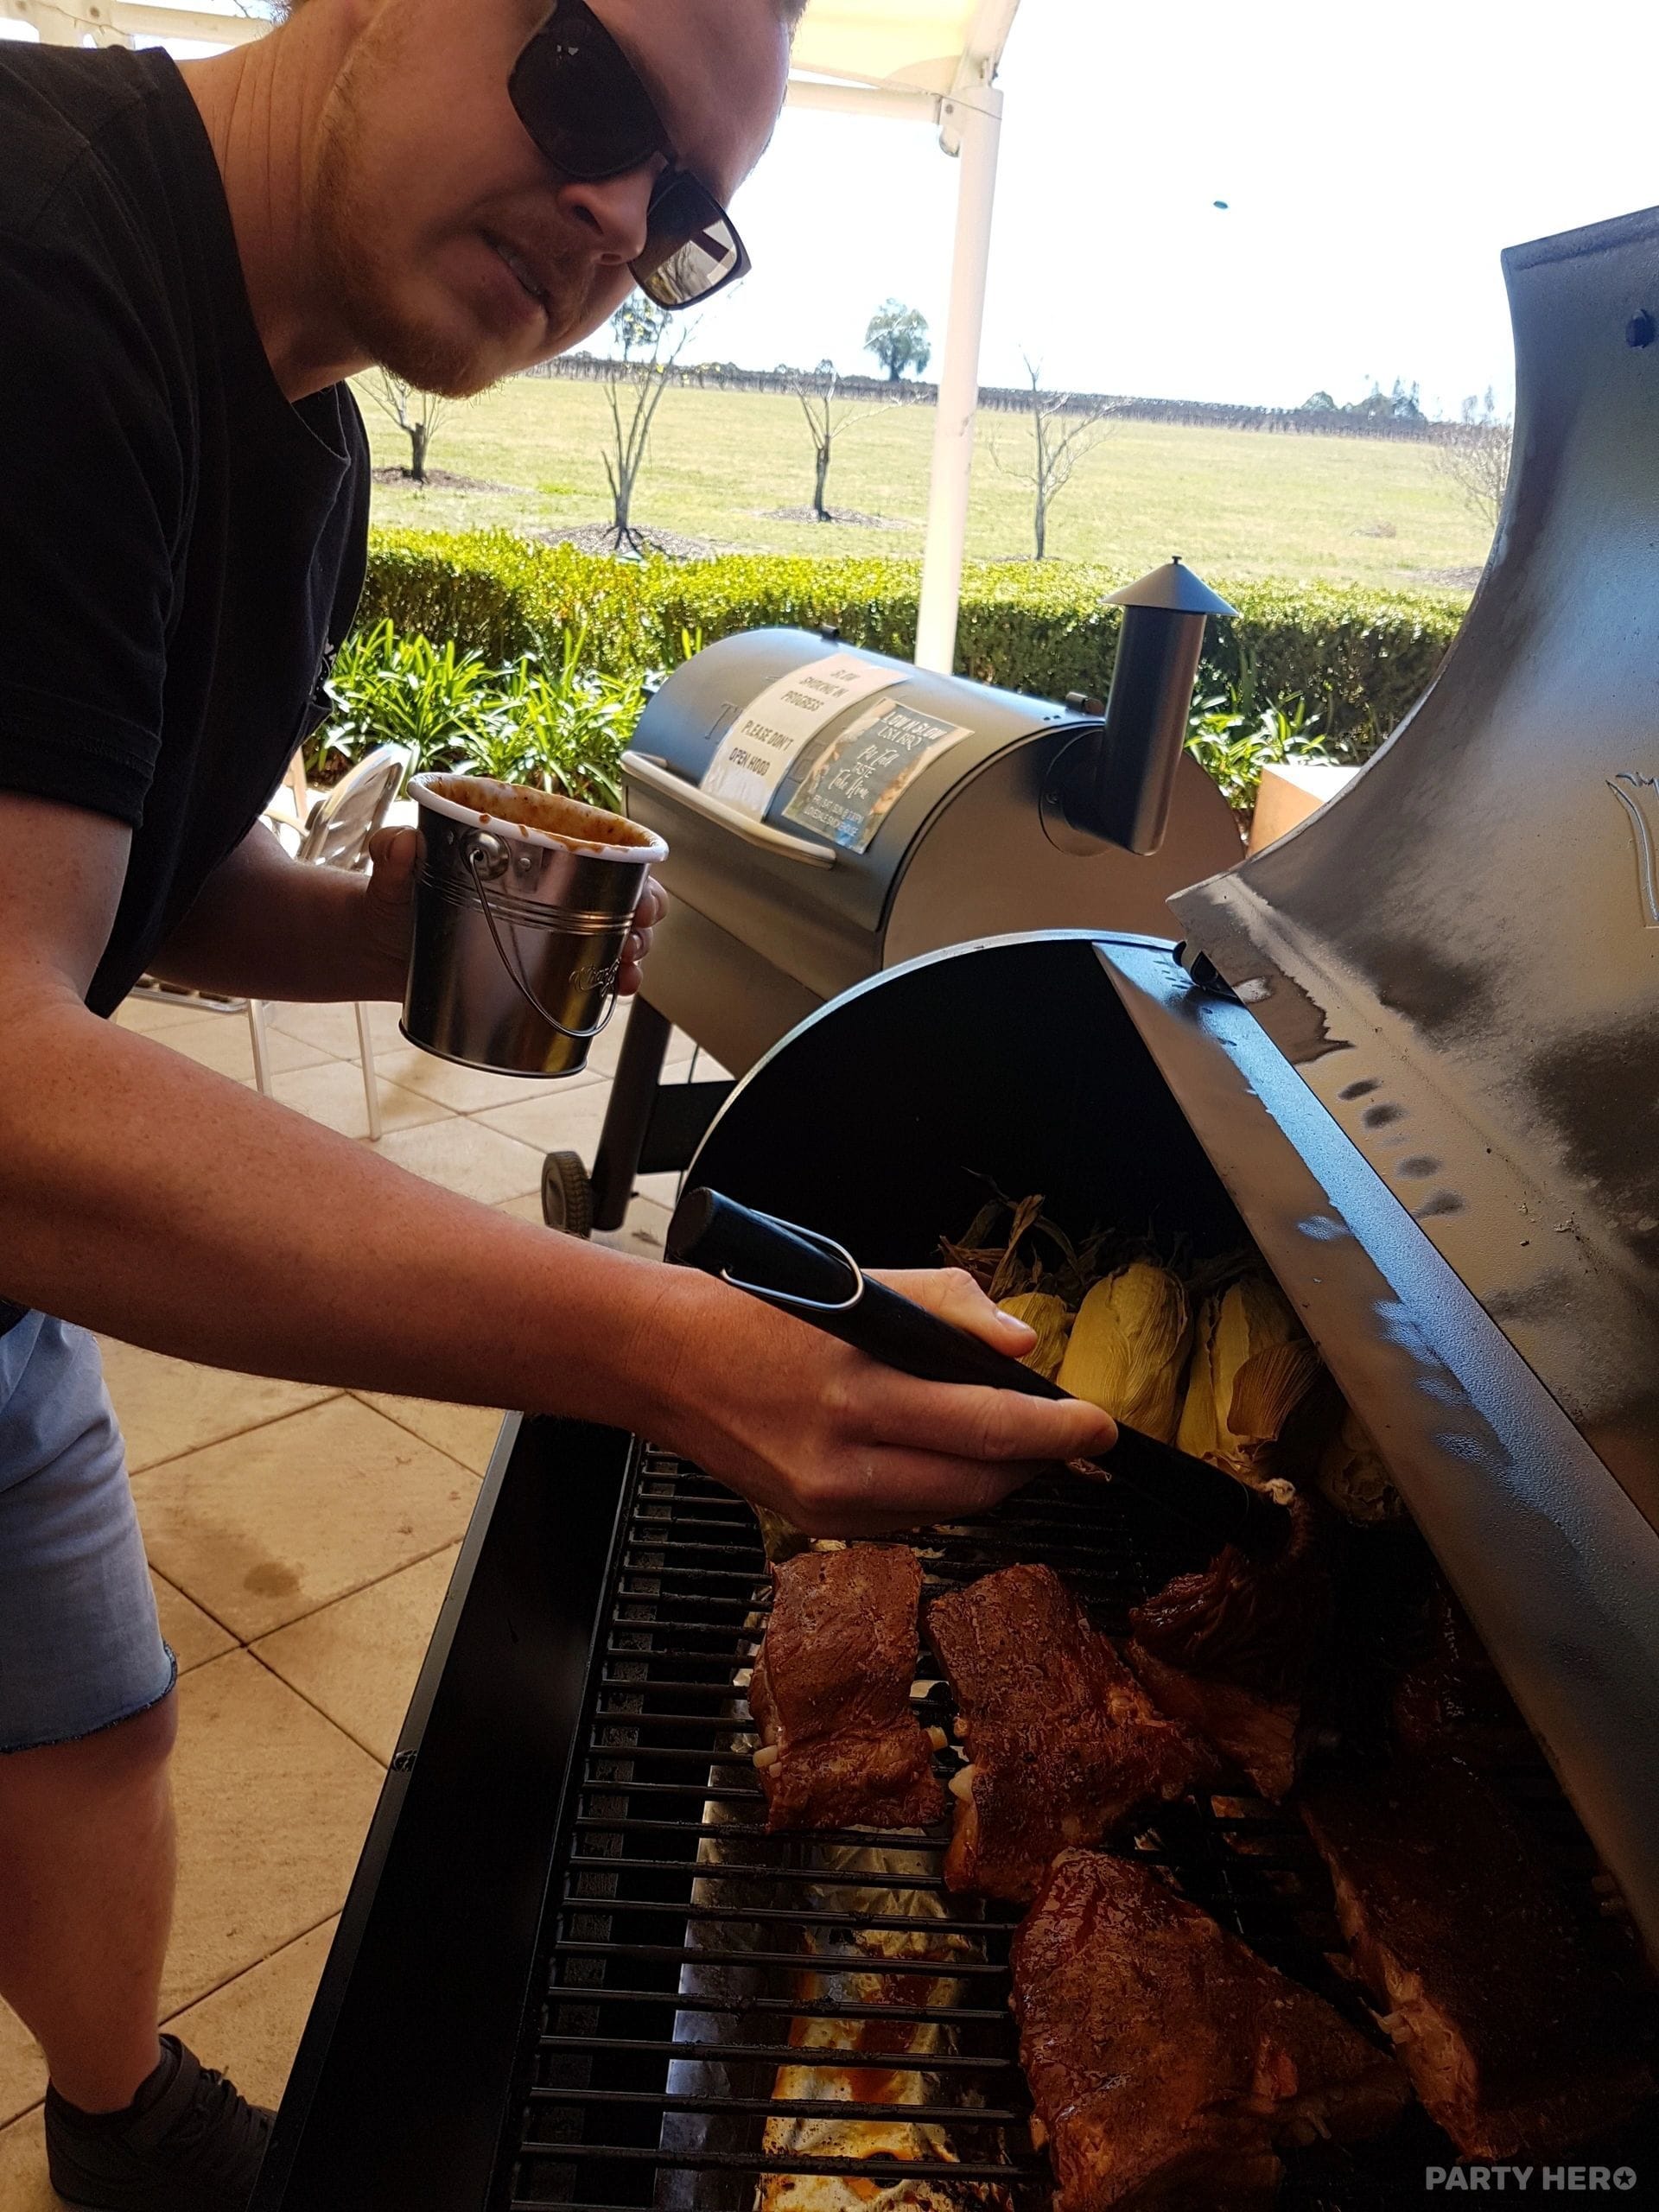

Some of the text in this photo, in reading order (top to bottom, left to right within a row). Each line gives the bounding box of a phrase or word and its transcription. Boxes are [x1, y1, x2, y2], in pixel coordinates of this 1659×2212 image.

[781, 690, 824, 711] PROGRESS
[741, 720, 773, 741] PLEASE
[767, 732, 794, 751] DON'T
[880, 711, 912, 728] LOW
[912, 722, 948, 740] SLOW
[878, 727, 922, 751] USA BBQ
[729, 747, 770, 776] OPEN HOOD
[854, 761, 876, 778] TASTE
